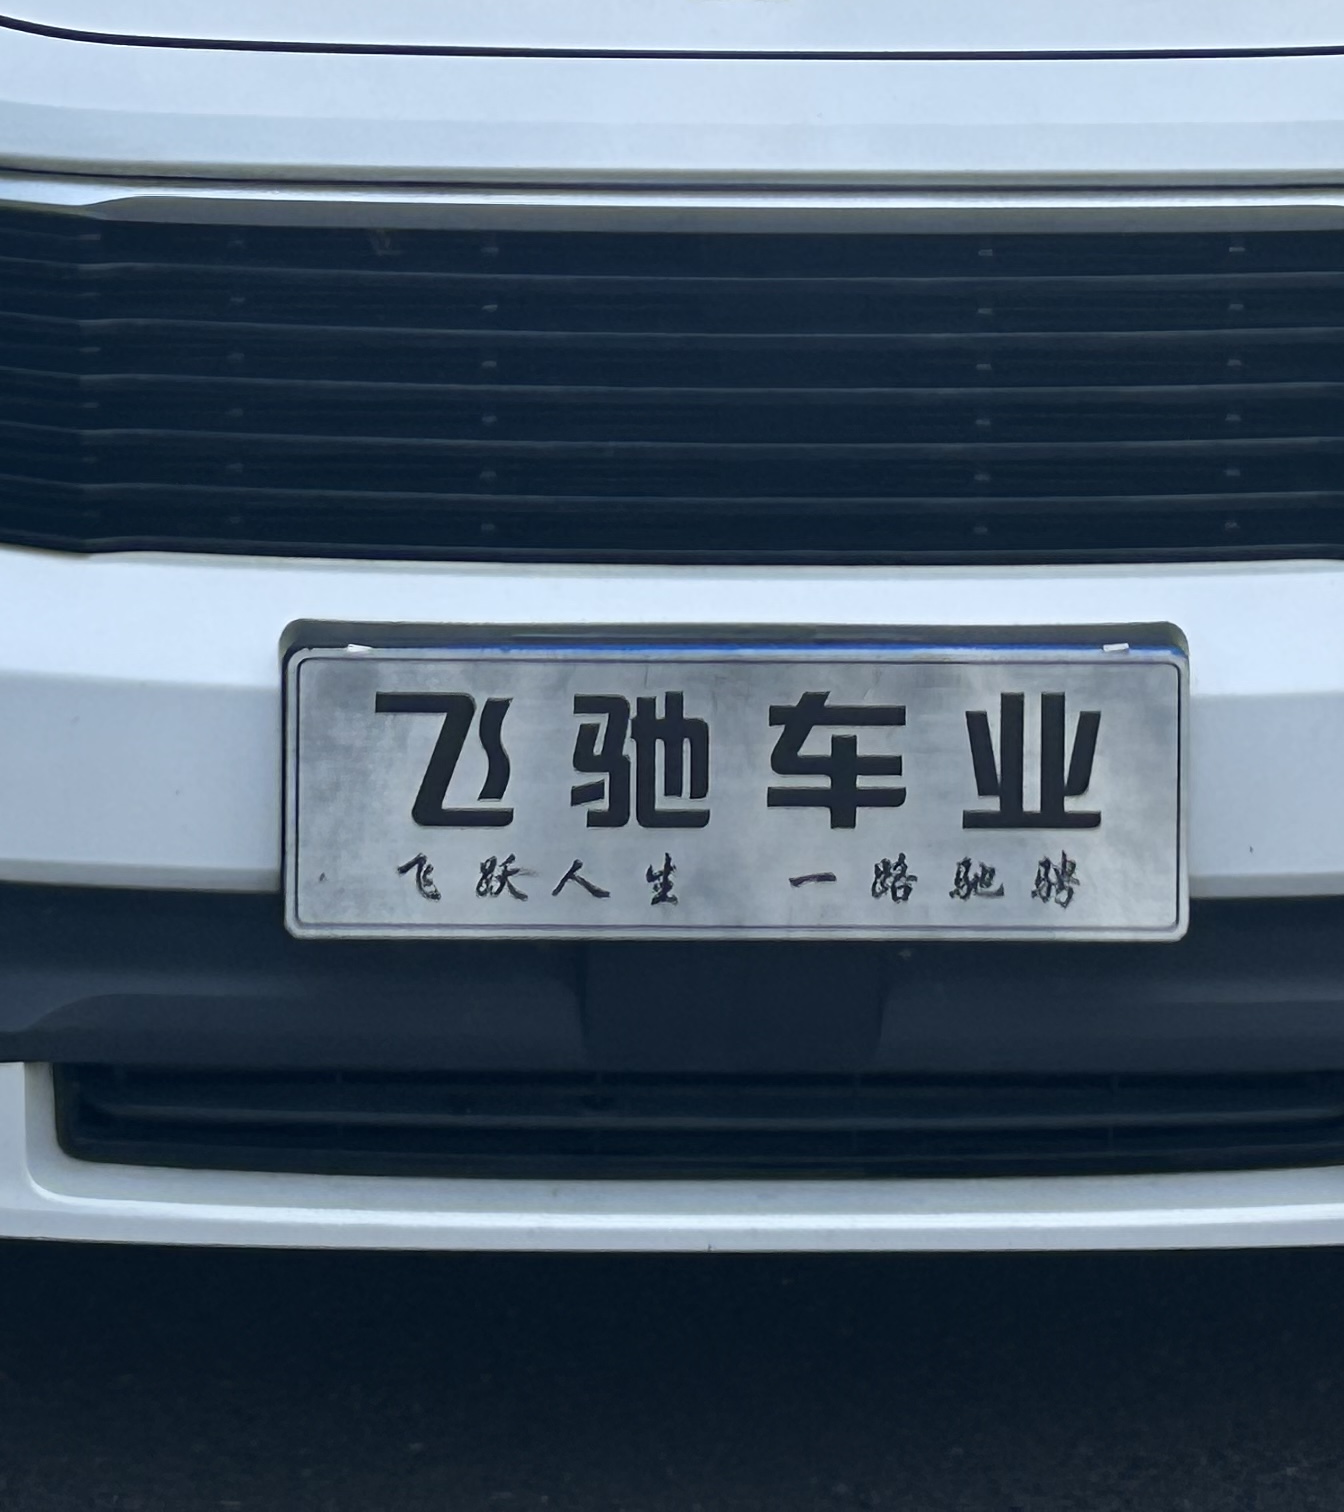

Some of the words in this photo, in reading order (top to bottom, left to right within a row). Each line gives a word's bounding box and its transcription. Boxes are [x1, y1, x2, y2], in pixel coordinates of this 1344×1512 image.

[375, 690, 1102, 830] 飞驰车业
[396, 852, 680, 906] 飞跃人生
[788, 851, 1082, 909] 一路驰骋
